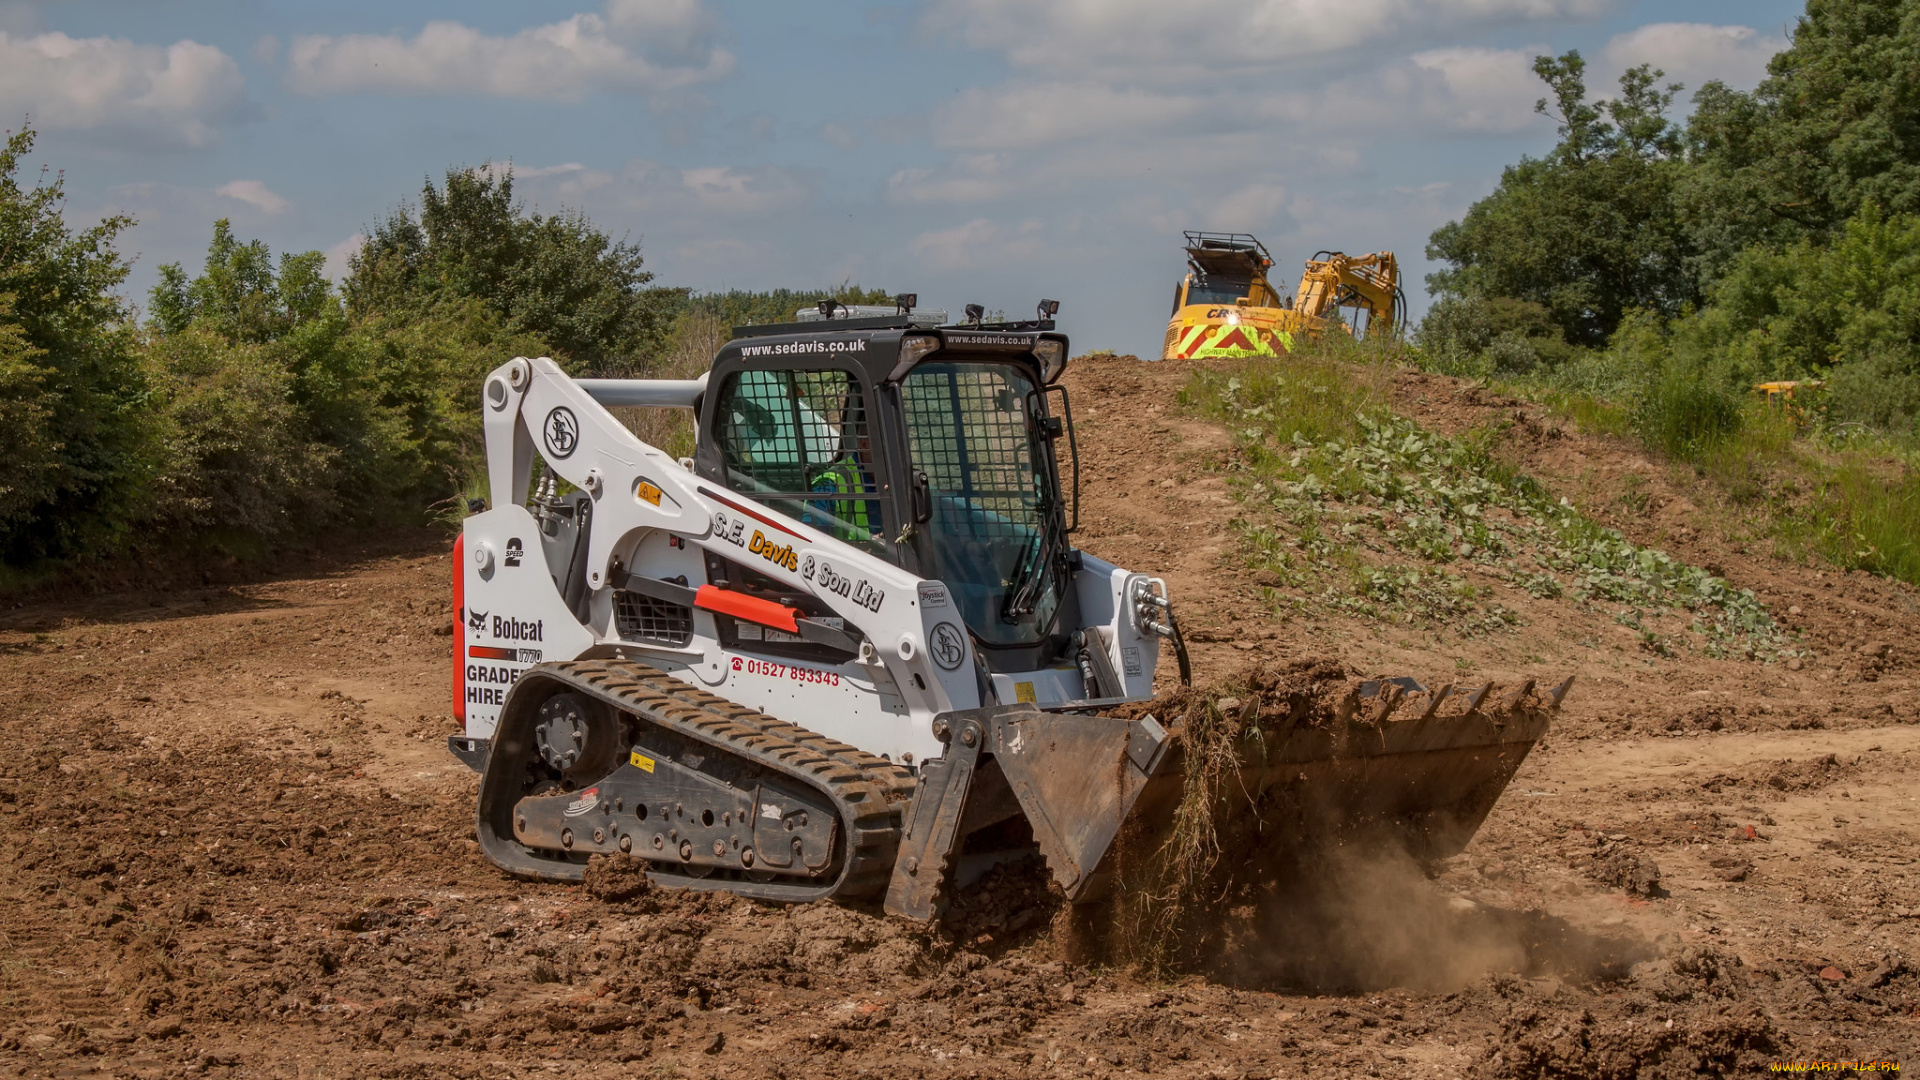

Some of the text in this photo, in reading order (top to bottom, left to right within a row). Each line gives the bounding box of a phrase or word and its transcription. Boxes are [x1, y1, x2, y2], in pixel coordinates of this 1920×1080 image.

[741, 338, 866, 357] www.sedavis.co.uk
[947, 335, 1032, 345] www.sedavis.co.uk
[712, 512, 885, 614] S.E. Davis & Son Ltd
[493, 615, 543, 642] Bobcat
[518, 648, 543, 664] T770
[467, 665, 525, 684] GRADE
[748, 660, 839, 686] 01527 893343
[467, 687, 503, 705] HIRE
